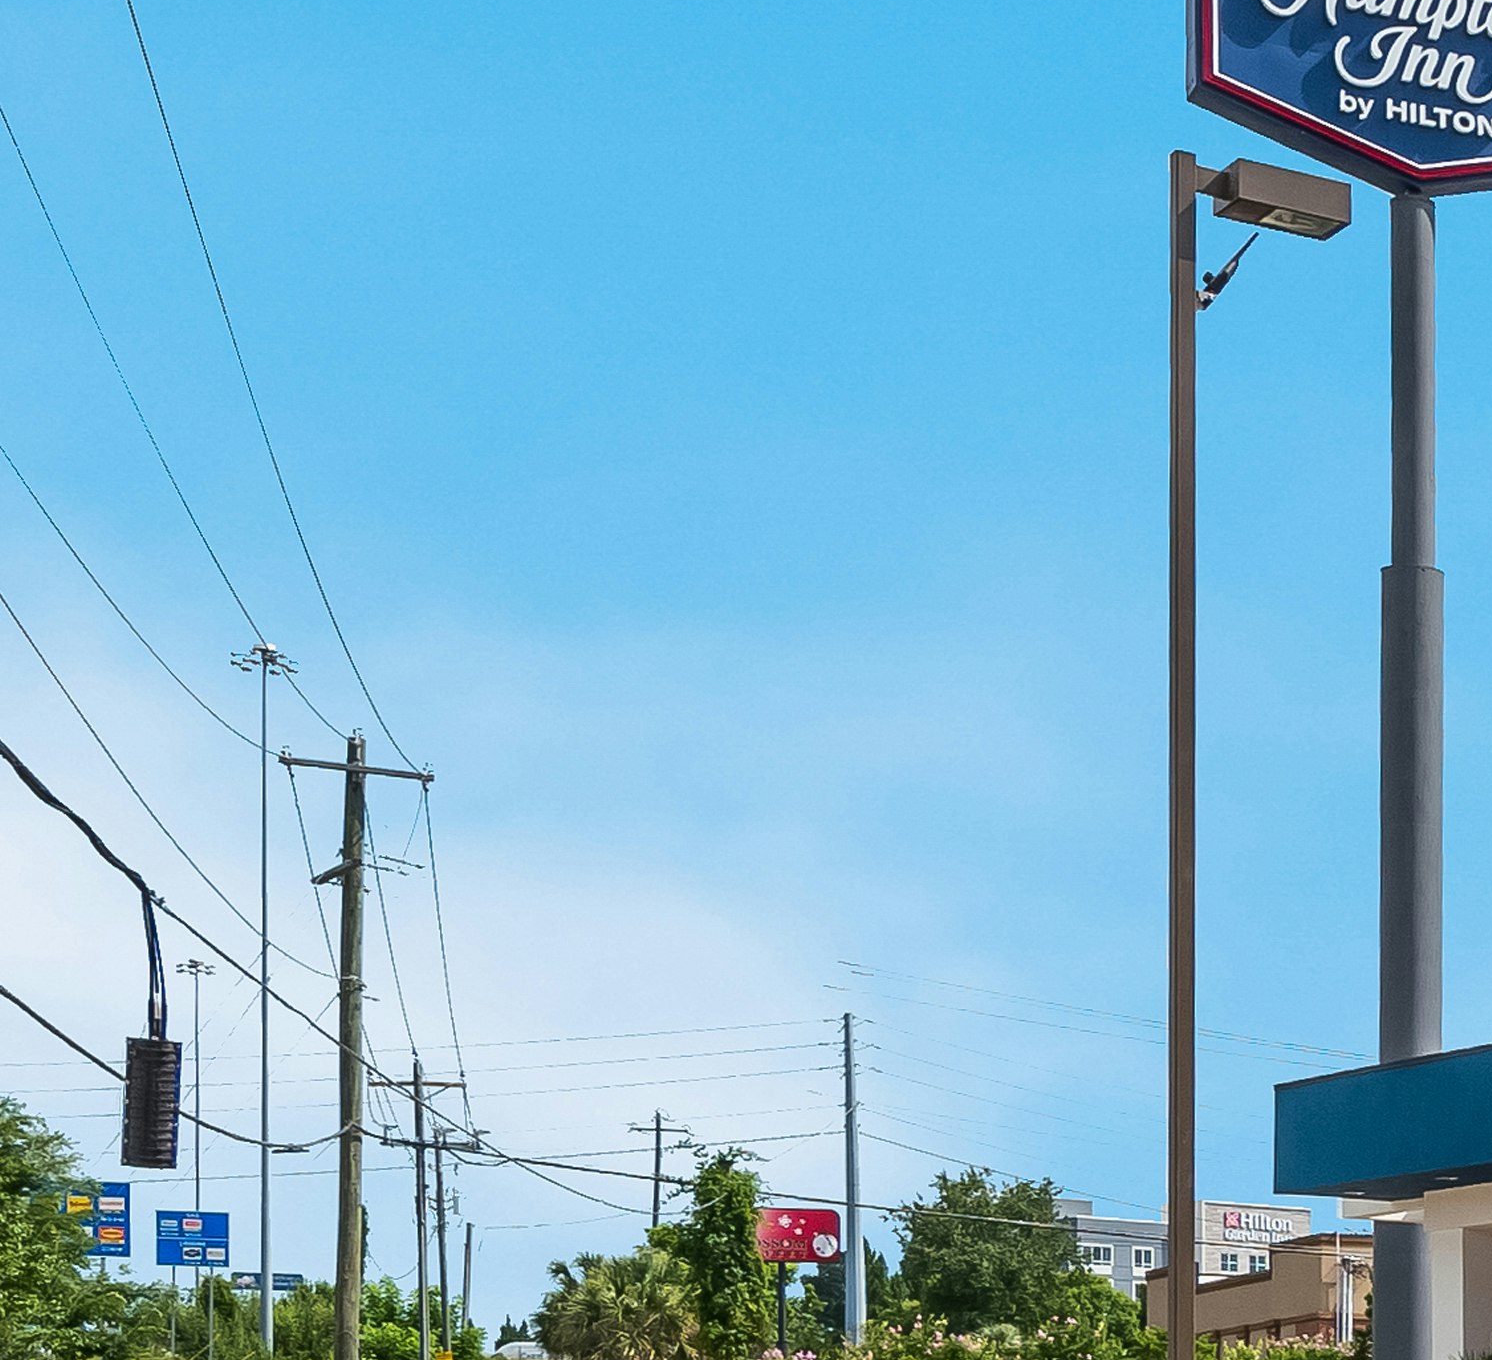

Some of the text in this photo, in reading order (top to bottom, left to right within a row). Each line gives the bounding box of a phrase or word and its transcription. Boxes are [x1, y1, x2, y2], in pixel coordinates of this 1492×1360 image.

[1339, 90, 1375, 120] by
[1240, 1212, 1293, 1233] Hilton
[1225, 1229, 1271, 1242] Garden
